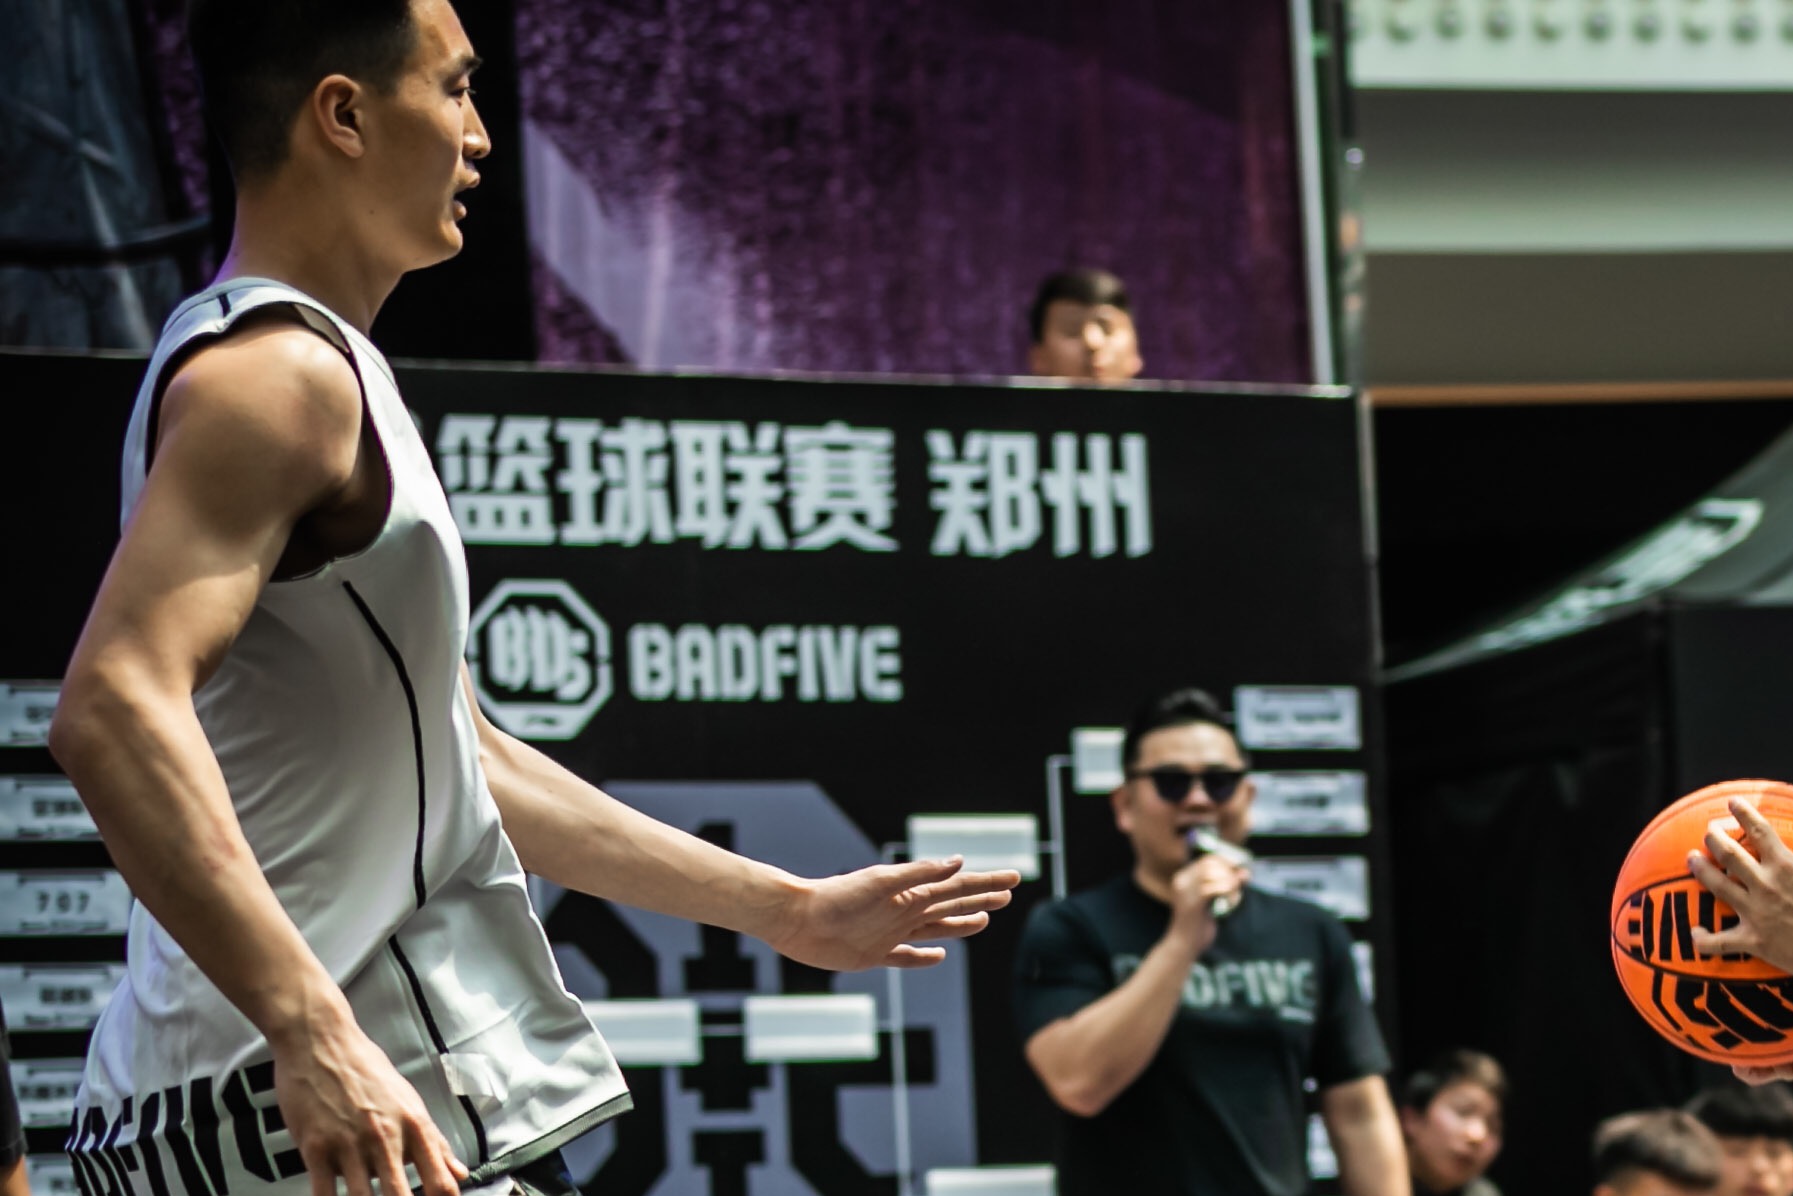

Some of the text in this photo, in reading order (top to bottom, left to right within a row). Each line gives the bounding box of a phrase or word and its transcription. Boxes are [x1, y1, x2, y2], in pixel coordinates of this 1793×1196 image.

[437, 414, 1153, 558] 篮球联赛 郑州
[628, 622, 904, 702] BADFIVE
